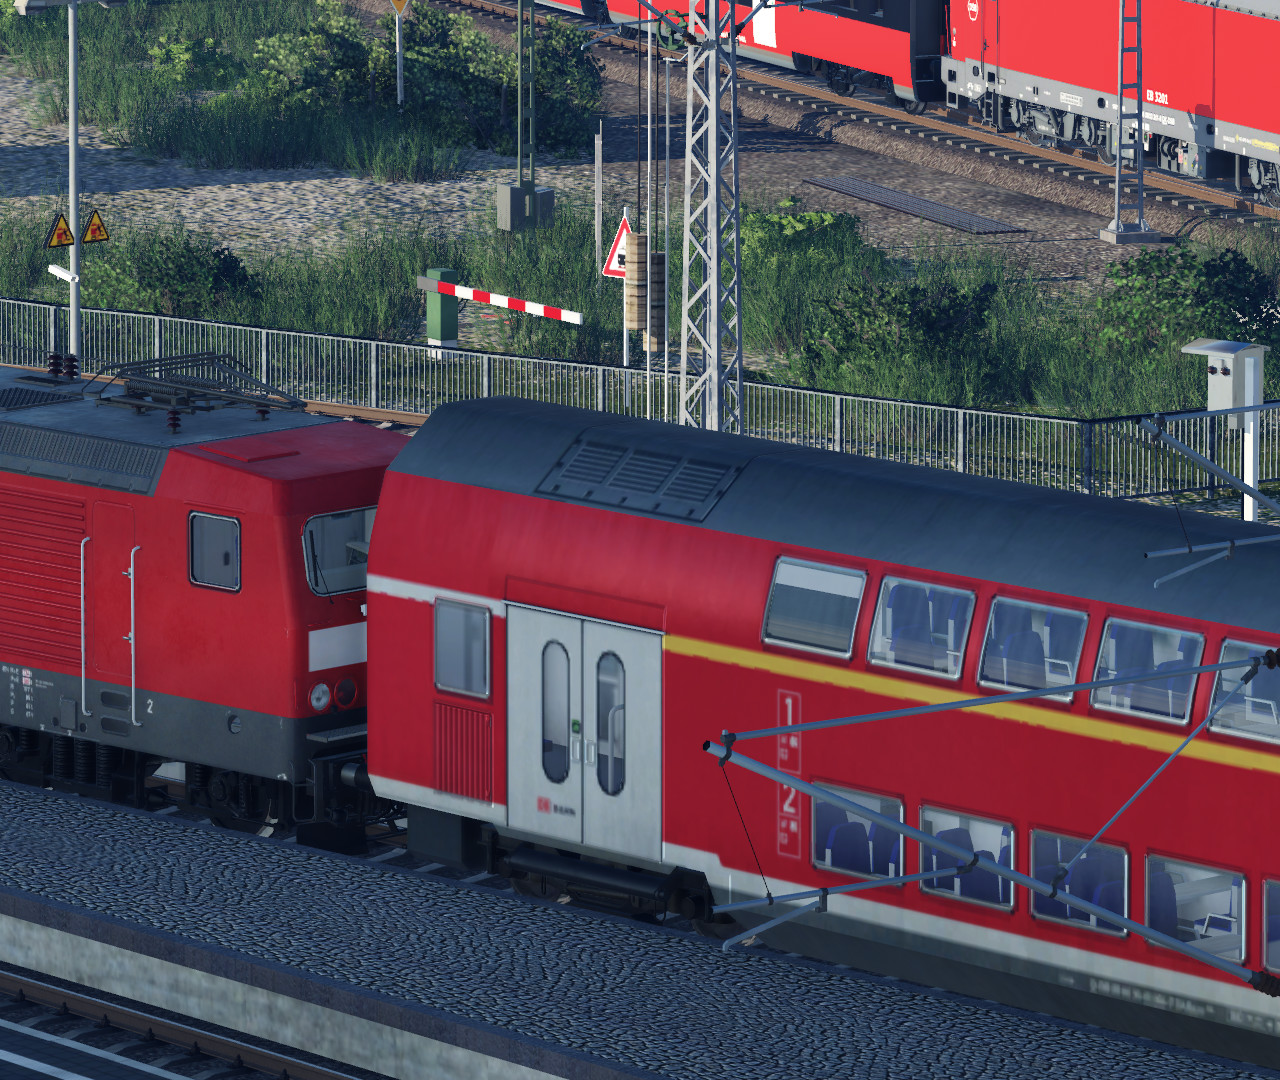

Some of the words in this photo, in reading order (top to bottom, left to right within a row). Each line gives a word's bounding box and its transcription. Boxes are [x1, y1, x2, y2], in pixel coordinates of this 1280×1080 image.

[146, 699, 154, 714] 2
[784, 696, 793, 726] 1
[782, 782, 796, 813] 2
